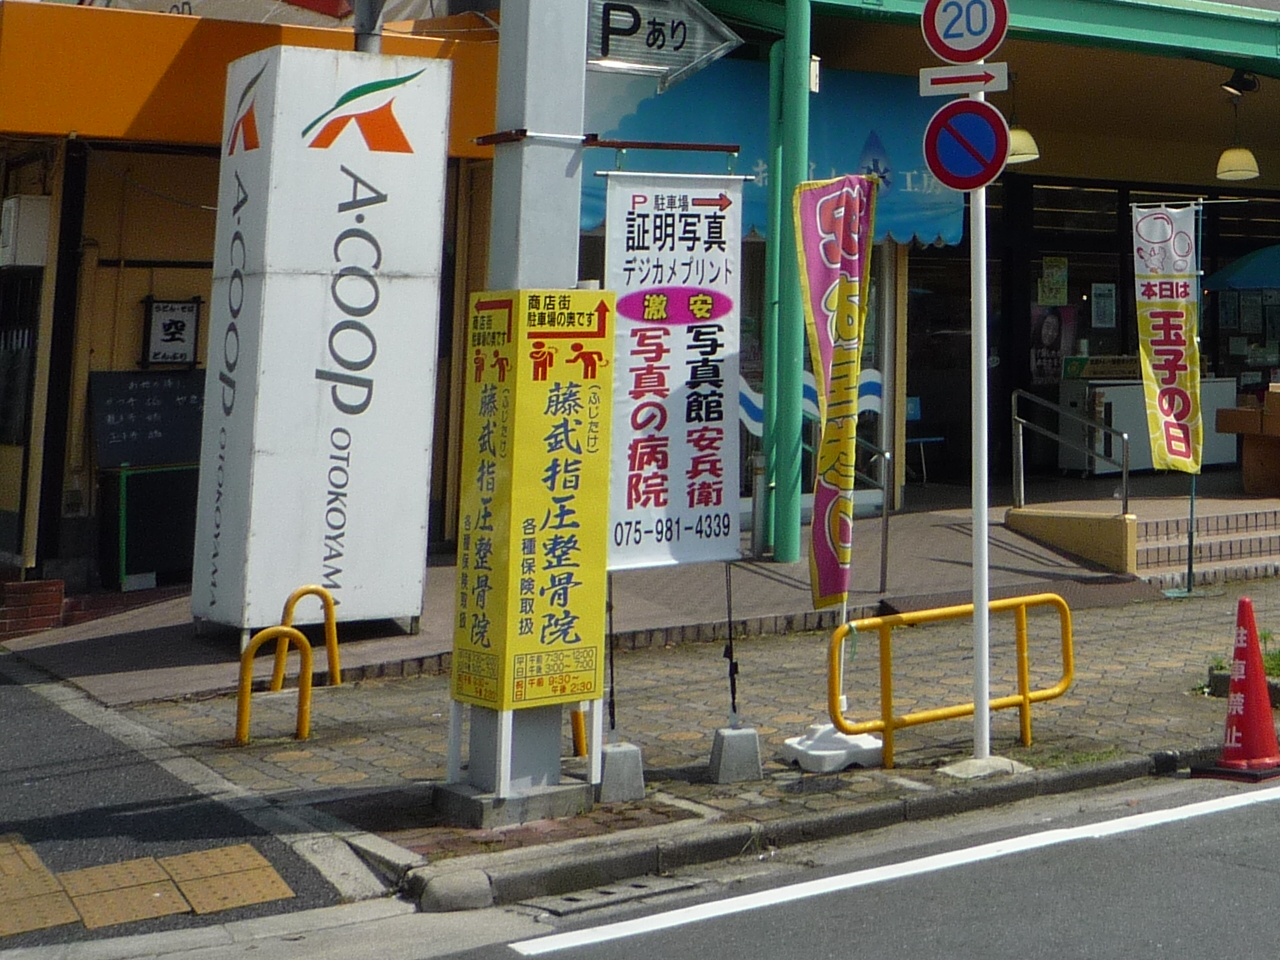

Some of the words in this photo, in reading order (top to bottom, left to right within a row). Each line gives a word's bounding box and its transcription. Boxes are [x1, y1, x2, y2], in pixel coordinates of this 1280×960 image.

[601, 3, 641, 57] P
[645, 16, 688, 51] あり
[631, 194, 648, 210] P
[653, 194, 689, 212] 駐車場
[625, 211, 727, 253] 証明写真
[623, 256, 733, 286] デジカメプリント
[528, 294, 571, 310] 商店街
[642, 293, 714, 320] 激安
[1140, 281, 1190, 300] 本日は
[160, 319, 186, 343] 空
[527, 311, 595, 328] 駐車場の奥です
[1149, 310, 1193, 460] 玉子の日
[626, 326, 671, 510] 写真の病院
[685, 323, 725, 509] 写真館安兵衛
[539, 381, 585, 645] 藤武指圧整骨院
[614, 512, 731, 547] 075-981-4339
[518, 518, 537, 636] 各種保険取扱
